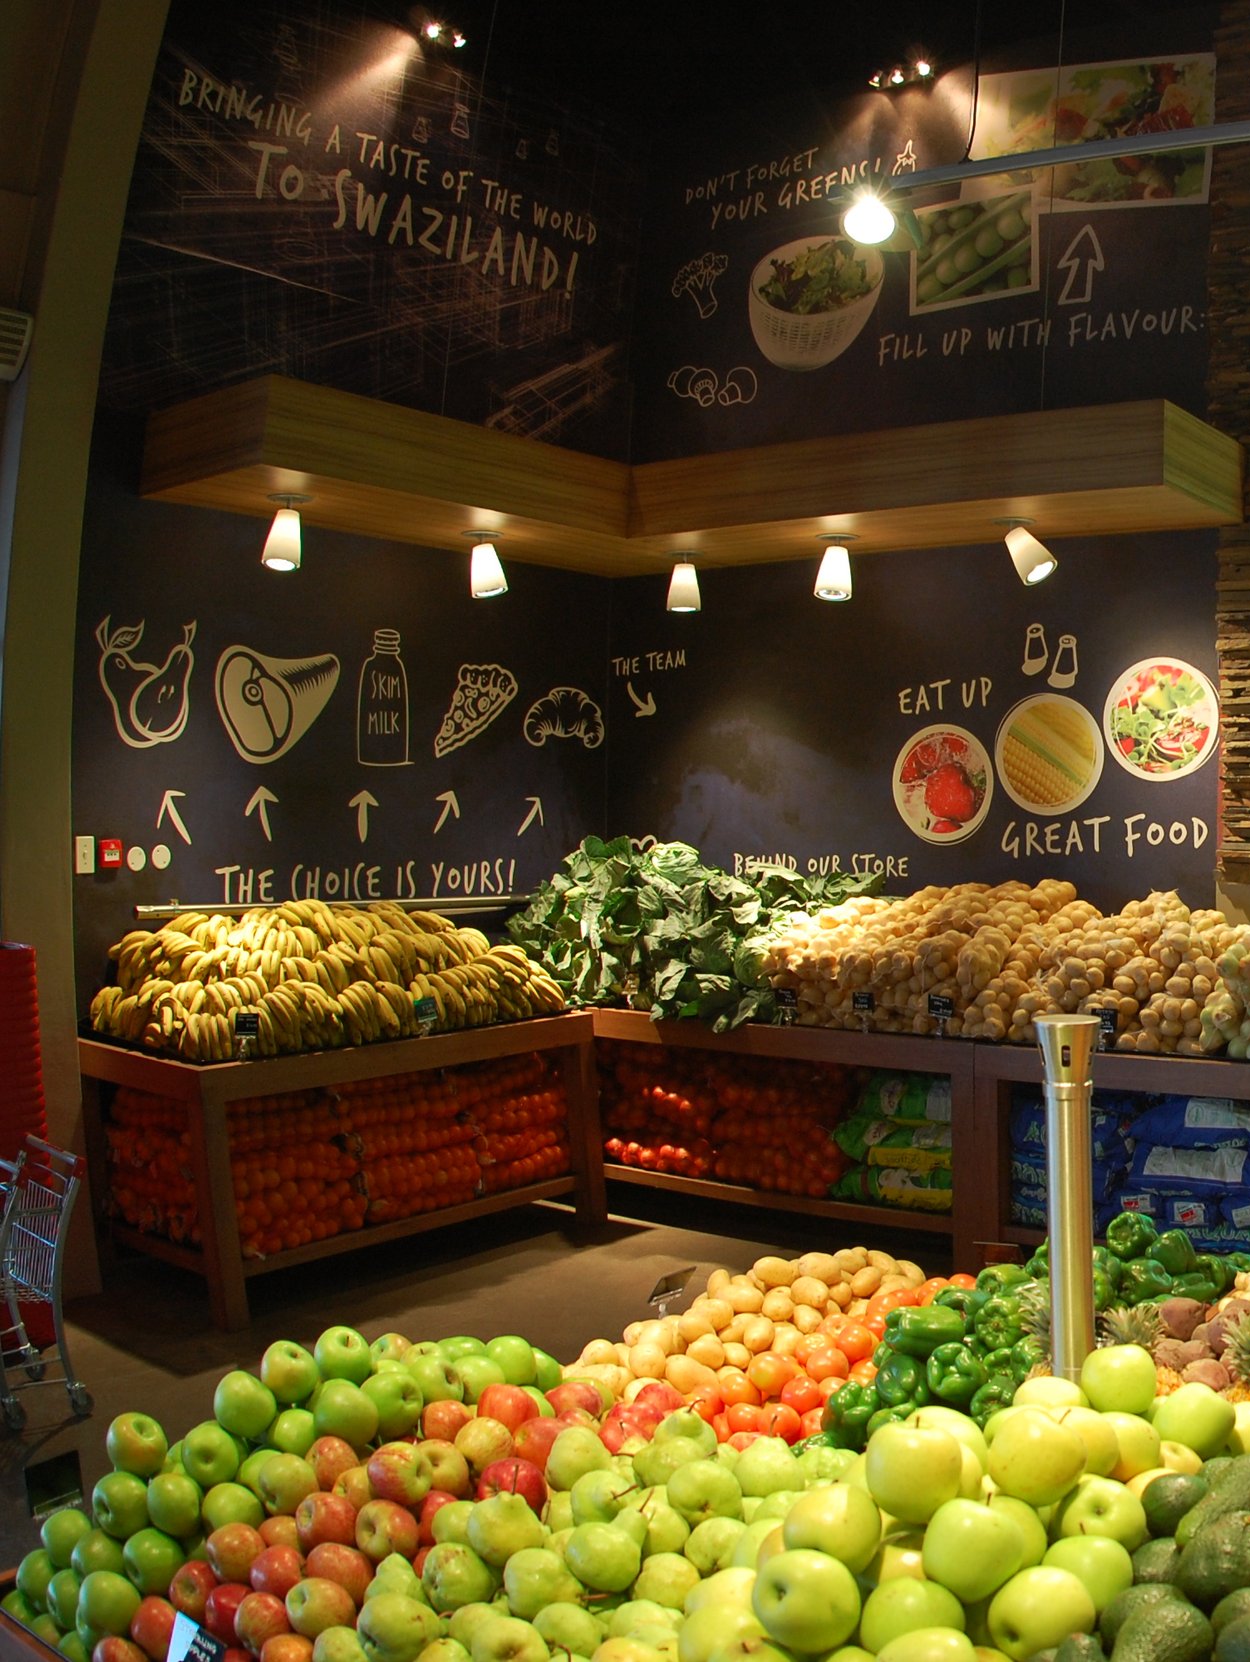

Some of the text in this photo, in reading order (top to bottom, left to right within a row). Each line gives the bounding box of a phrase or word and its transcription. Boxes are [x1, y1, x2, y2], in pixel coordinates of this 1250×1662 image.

[179, 68, 597, 245] BRINGING A TASTE OF THE WORLD
[685, 147, 819, 204] DON'T FORGET
[711, 191, 768, 230] YOUR
[332, 168, 579, 300] SWAZILAND!
[878, 333, 928, 367] FILL
[942, 327, 972, 356] UP
[987, 318, 1051, 351] WITH
[612, 649, 686, 676] THE TEAM
[371, 669, 401, 700] SKIM
[898, 676, 993, 715] EAT UP
[368, 710, 400, 735] MILK
[1000, 813, 1209, 859] GREAT FOOD
[215, 858, 516, 904] THE CHOICE IS YOURS!
[807, 854, 842, 877] OUR
[851, 853, 909, 878] STORE
